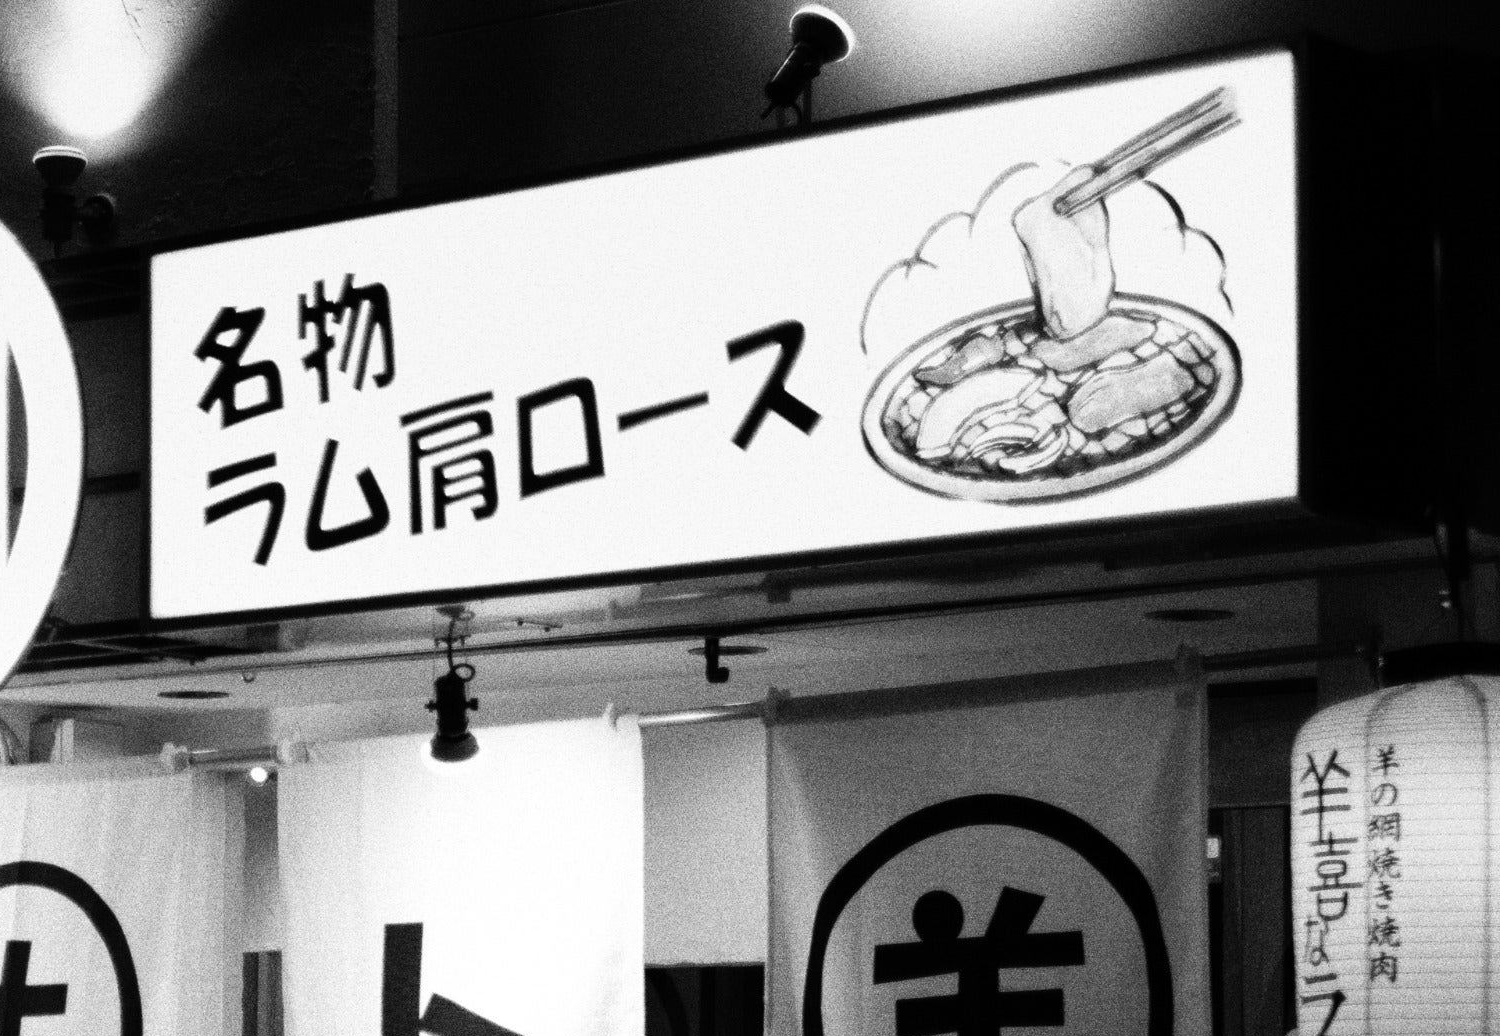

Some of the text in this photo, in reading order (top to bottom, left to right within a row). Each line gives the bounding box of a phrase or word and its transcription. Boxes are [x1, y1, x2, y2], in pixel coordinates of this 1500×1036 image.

[193, 272, 396, 430] 名物
[203, 319, 823, 567] ラム肩ロース
